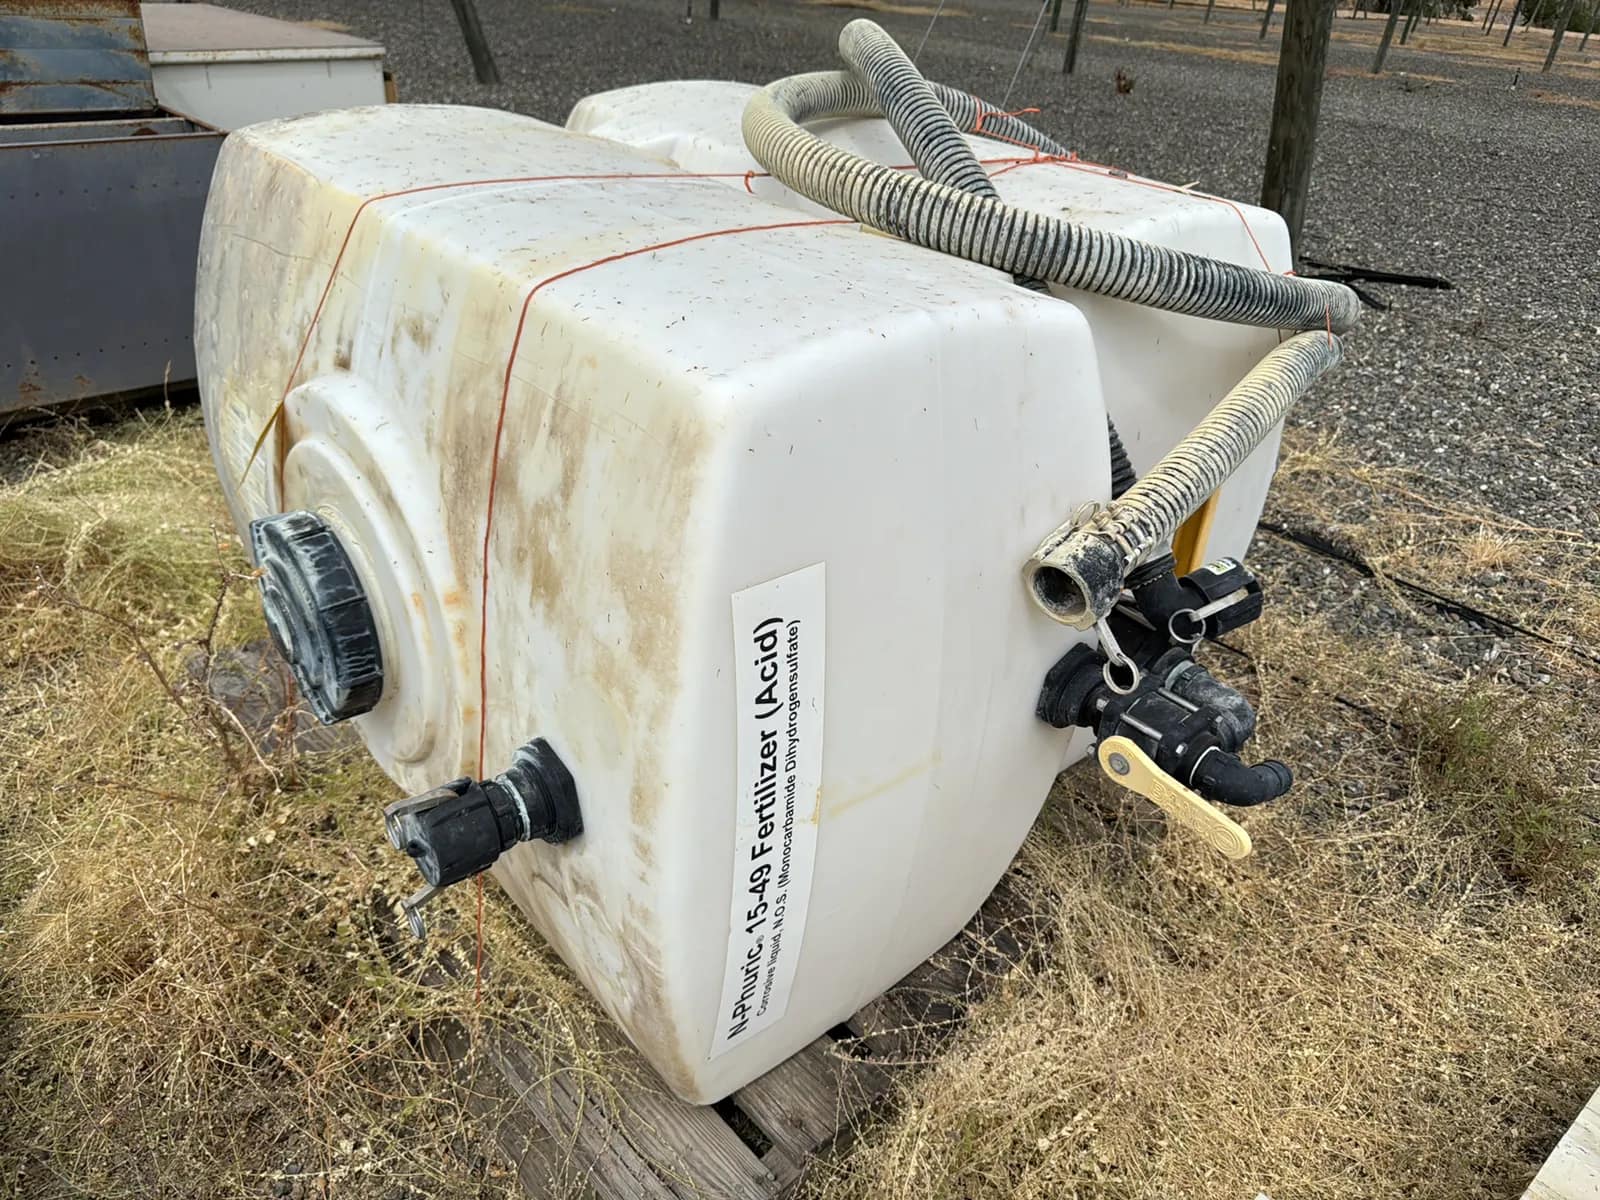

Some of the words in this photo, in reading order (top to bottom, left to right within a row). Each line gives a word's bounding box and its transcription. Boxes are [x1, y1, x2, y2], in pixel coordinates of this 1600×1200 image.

[753, 617, 784, 719] (Acid)
[785, 619, 801, 773] Dihydrogensulfate)
[751, 730, 778, 861] Fertilizer
[777, 774, 796, 889] (Monocarbamide
[745, 863, 771, 934] 15-49
[772, 889, 788, 930] N.O.S.
[767, 929, 783, 967] liquid,
[756, 966, 776, 1017] Corrosive
